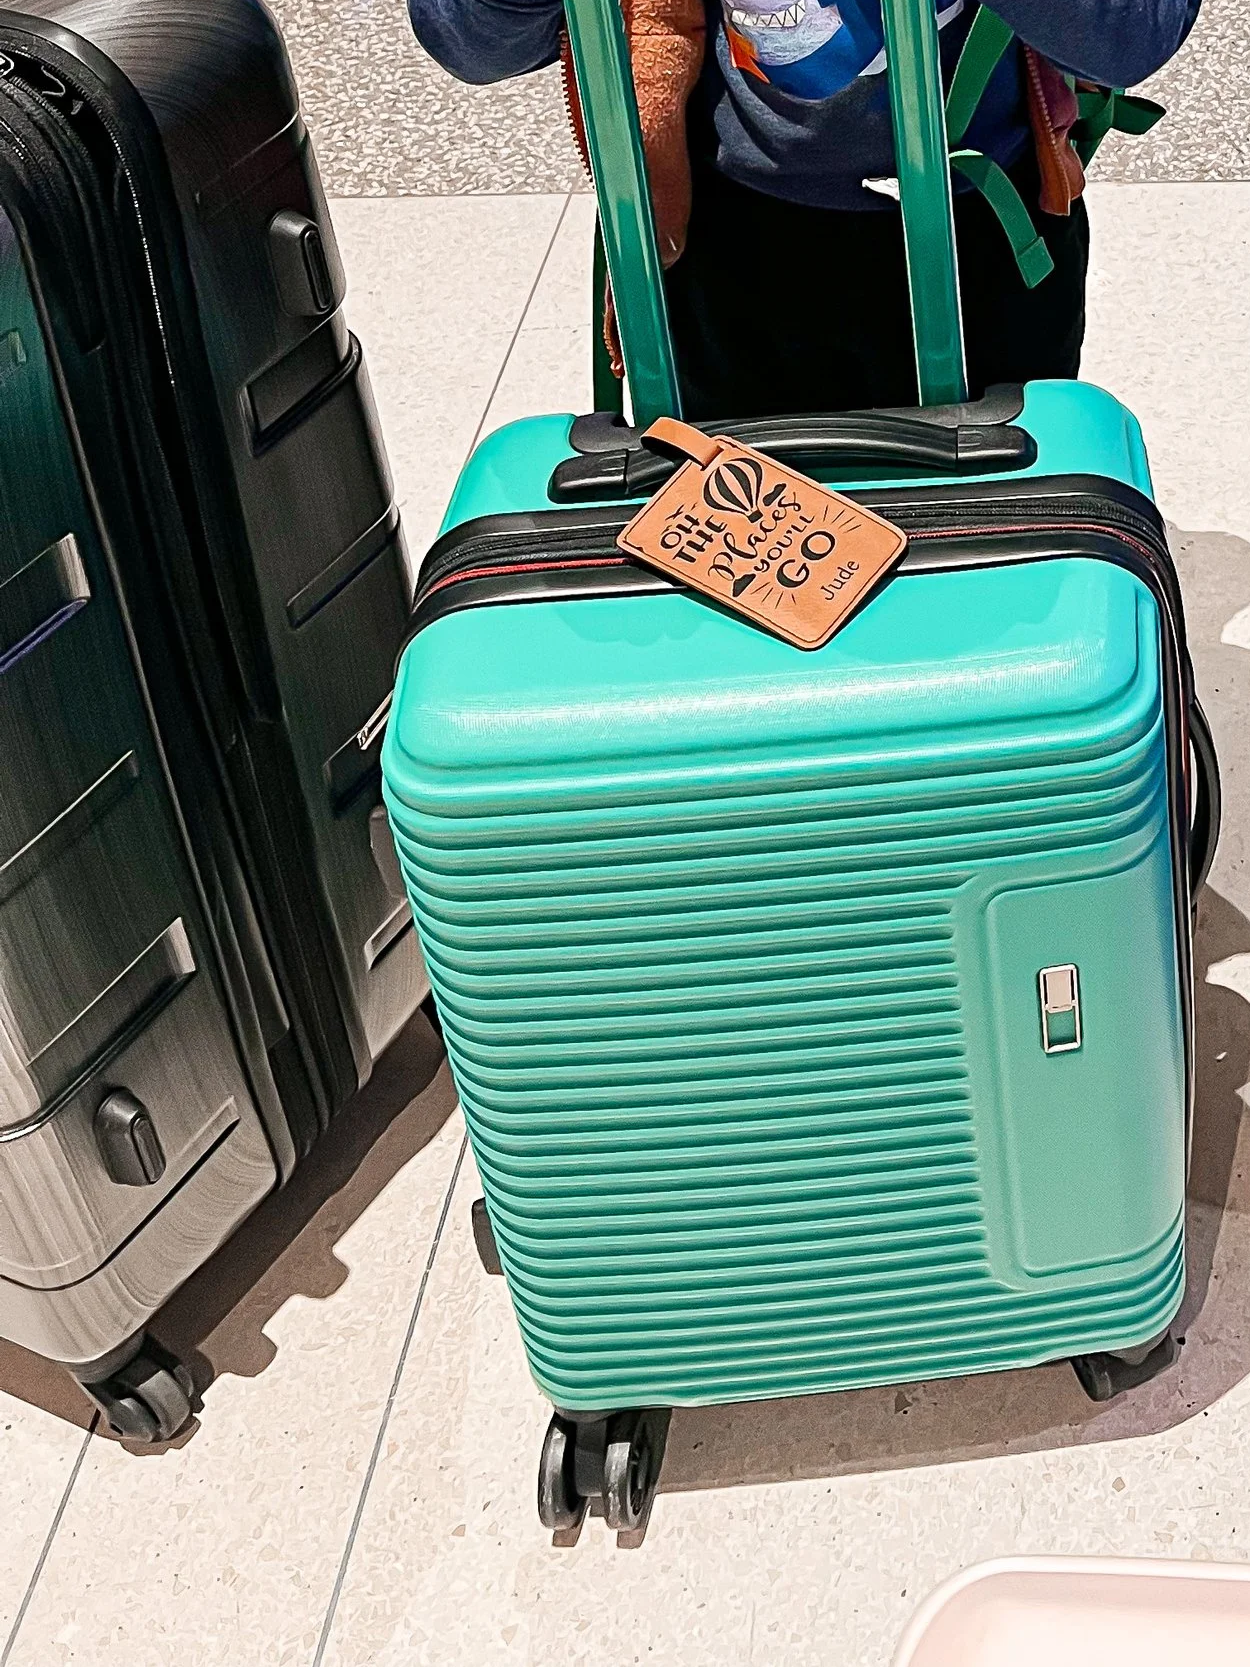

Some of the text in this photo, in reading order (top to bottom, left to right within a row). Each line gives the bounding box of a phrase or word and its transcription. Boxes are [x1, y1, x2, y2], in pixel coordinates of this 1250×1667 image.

[660, 513, 700, 550] OH
[672, 515, 728, 564] THE
[776, 530, 836, 589] GO
[819, 558, 860, 601] Jude
